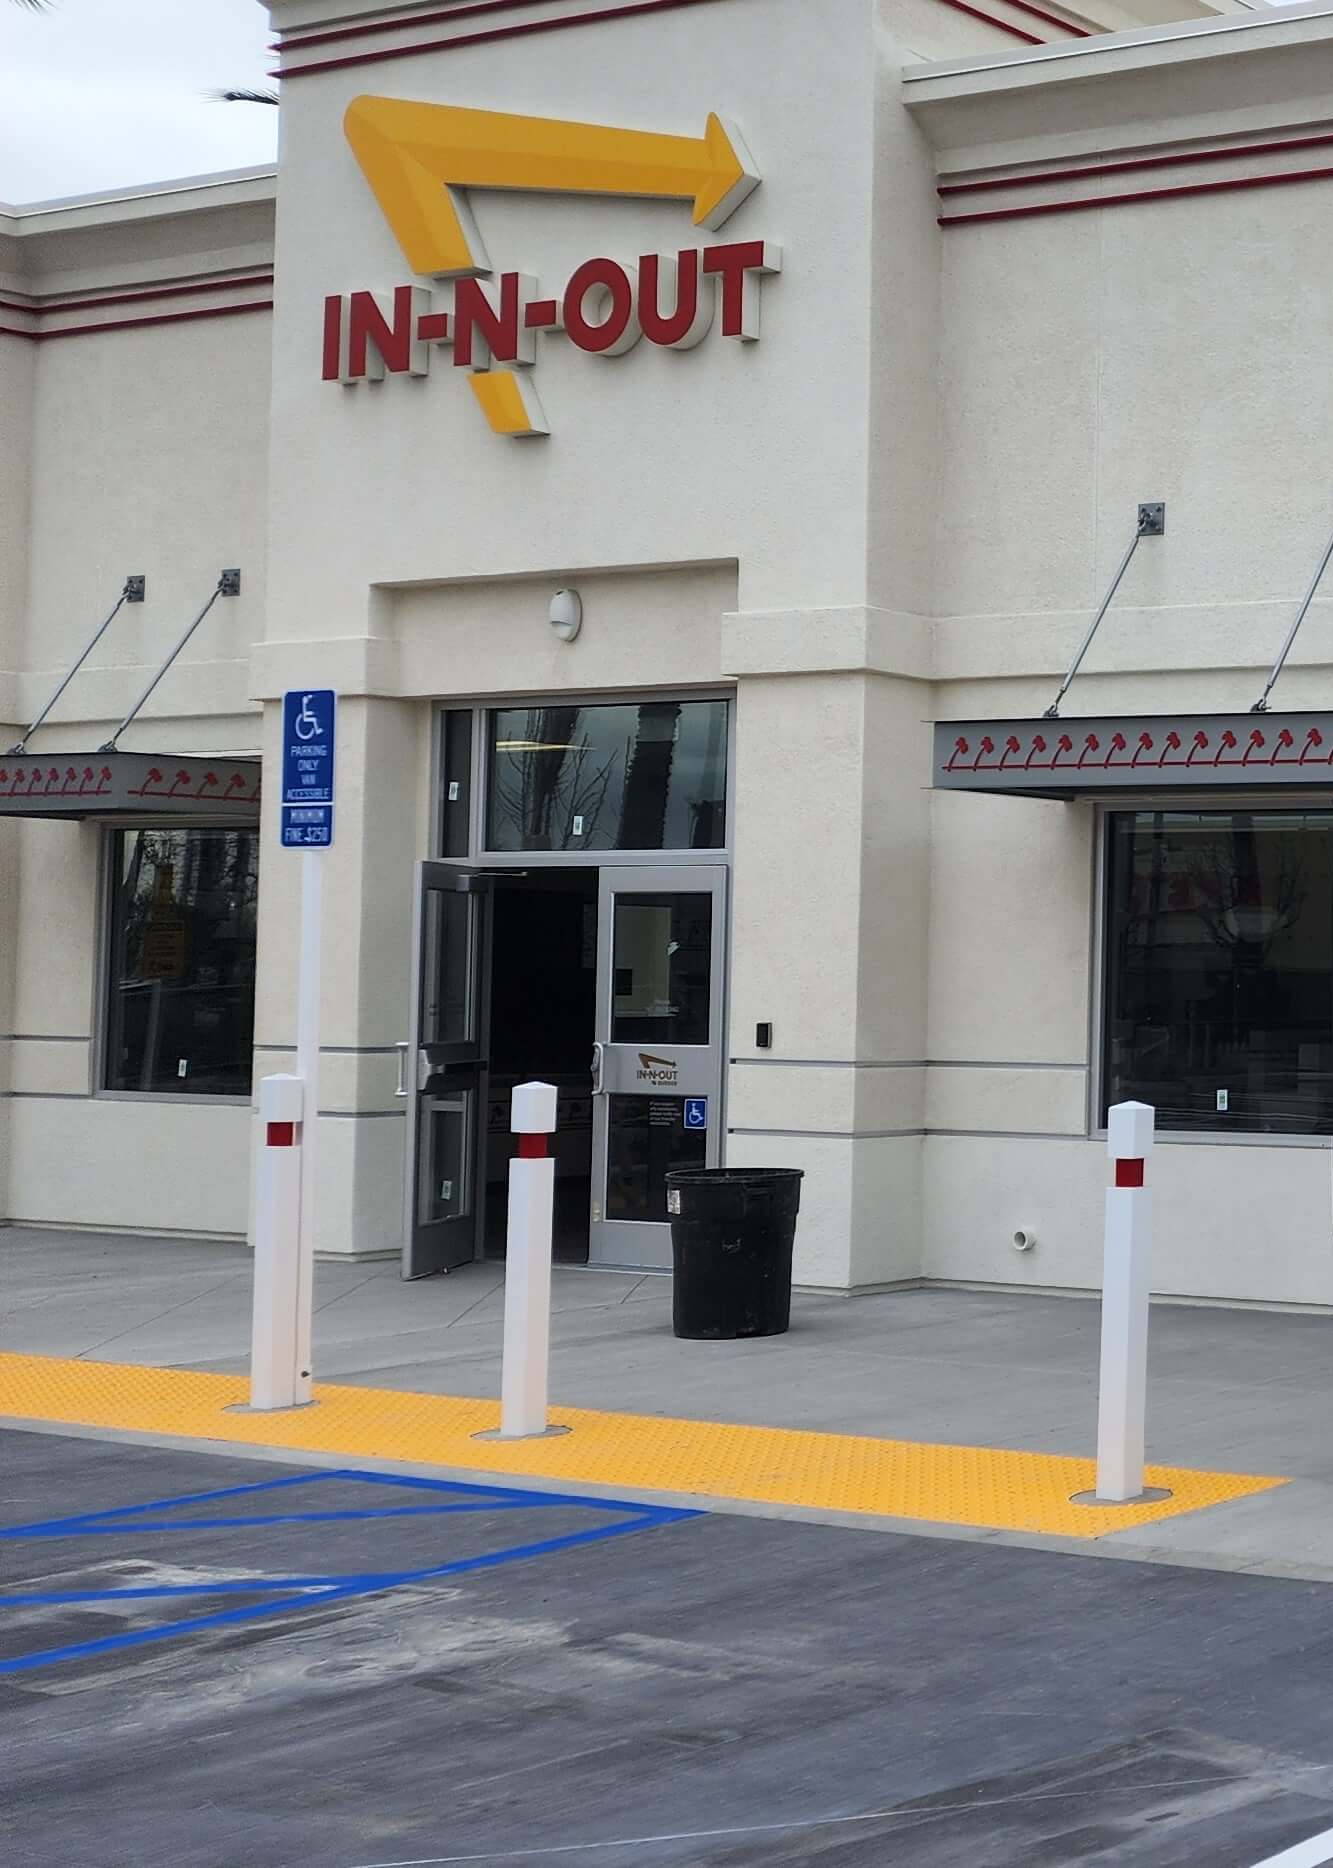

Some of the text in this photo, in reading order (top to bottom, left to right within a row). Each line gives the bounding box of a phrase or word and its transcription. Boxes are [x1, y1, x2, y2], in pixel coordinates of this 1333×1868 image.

[322, 241, 768, 383] IN-N-OUT
[291, 744, 328, 757] PARKING
[297, 759, 320, 771] ONLY
[285, 828, 304, 842] FINE
[636, 1070, 679, 1081] IN-N-OUT
